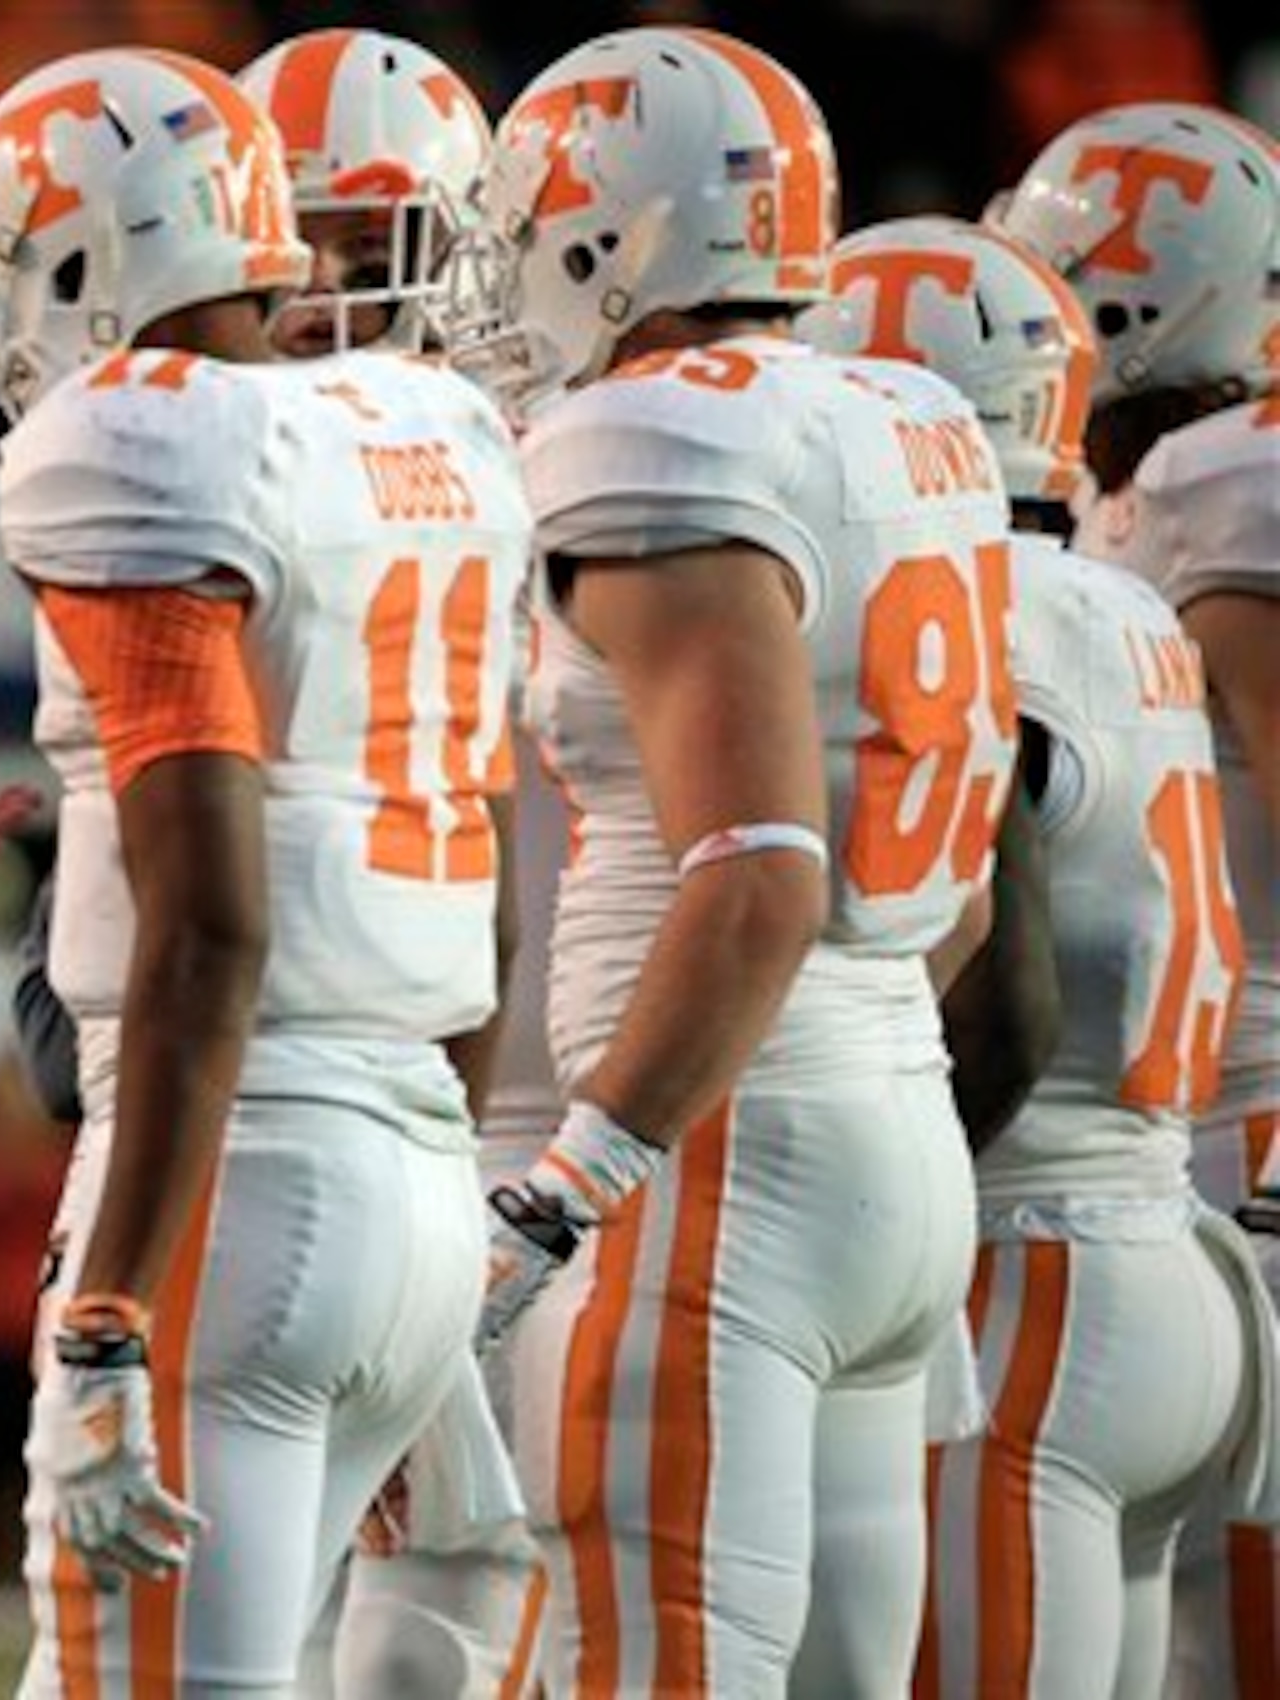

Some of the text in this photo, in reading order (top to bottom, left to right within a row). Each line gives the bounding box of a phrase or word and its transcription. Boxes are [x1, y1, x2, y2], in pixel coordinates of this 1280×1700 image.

[1070, 143, 1214, 276] T
[828, 250, 975, 363] T
[361, 559, 495, 881] 11
